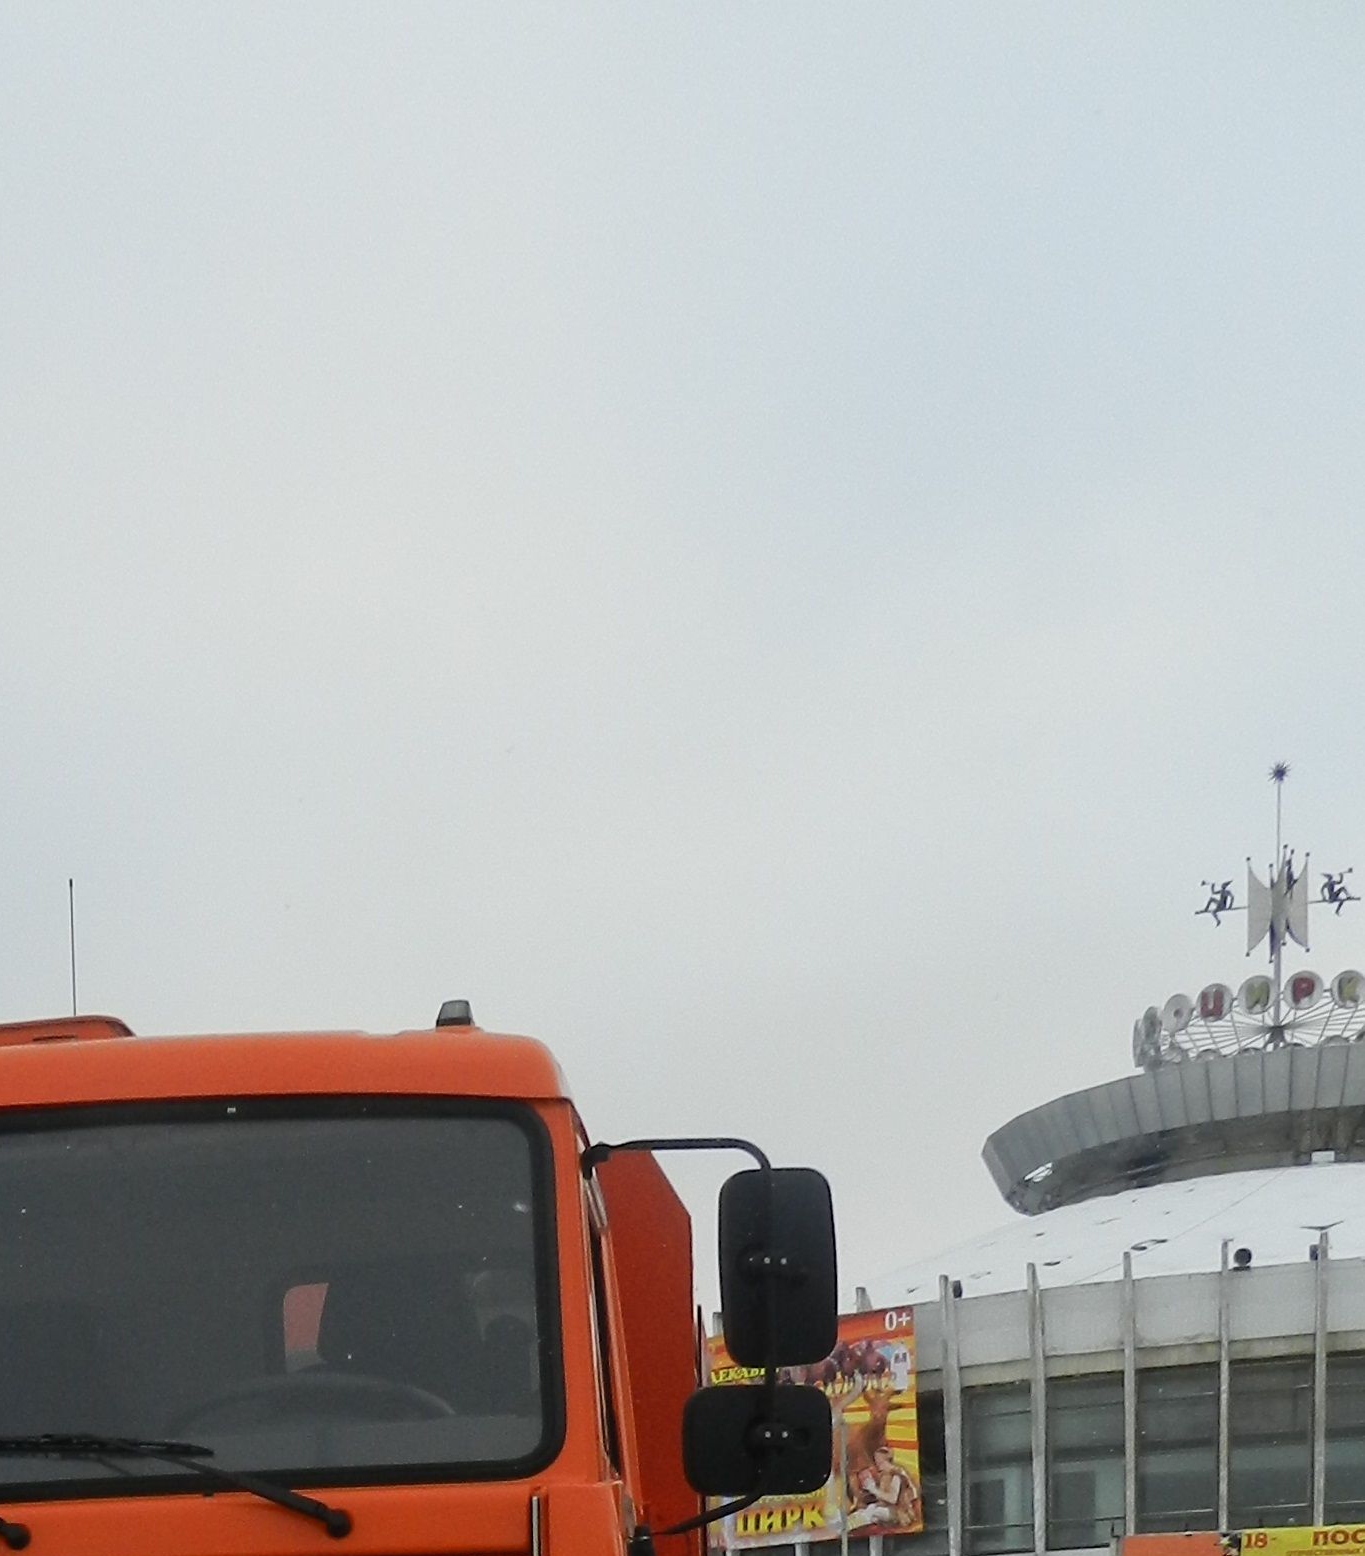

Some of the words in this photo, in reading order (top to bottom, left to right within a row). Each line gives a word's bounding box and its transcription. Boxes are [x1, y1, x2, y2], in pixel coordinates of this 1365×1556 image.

[885, 1311, 911, 1331] 0+
[737, 1502, 825, 1537] ЦИРК
[1244, 1532, 1267, 1549] 18
